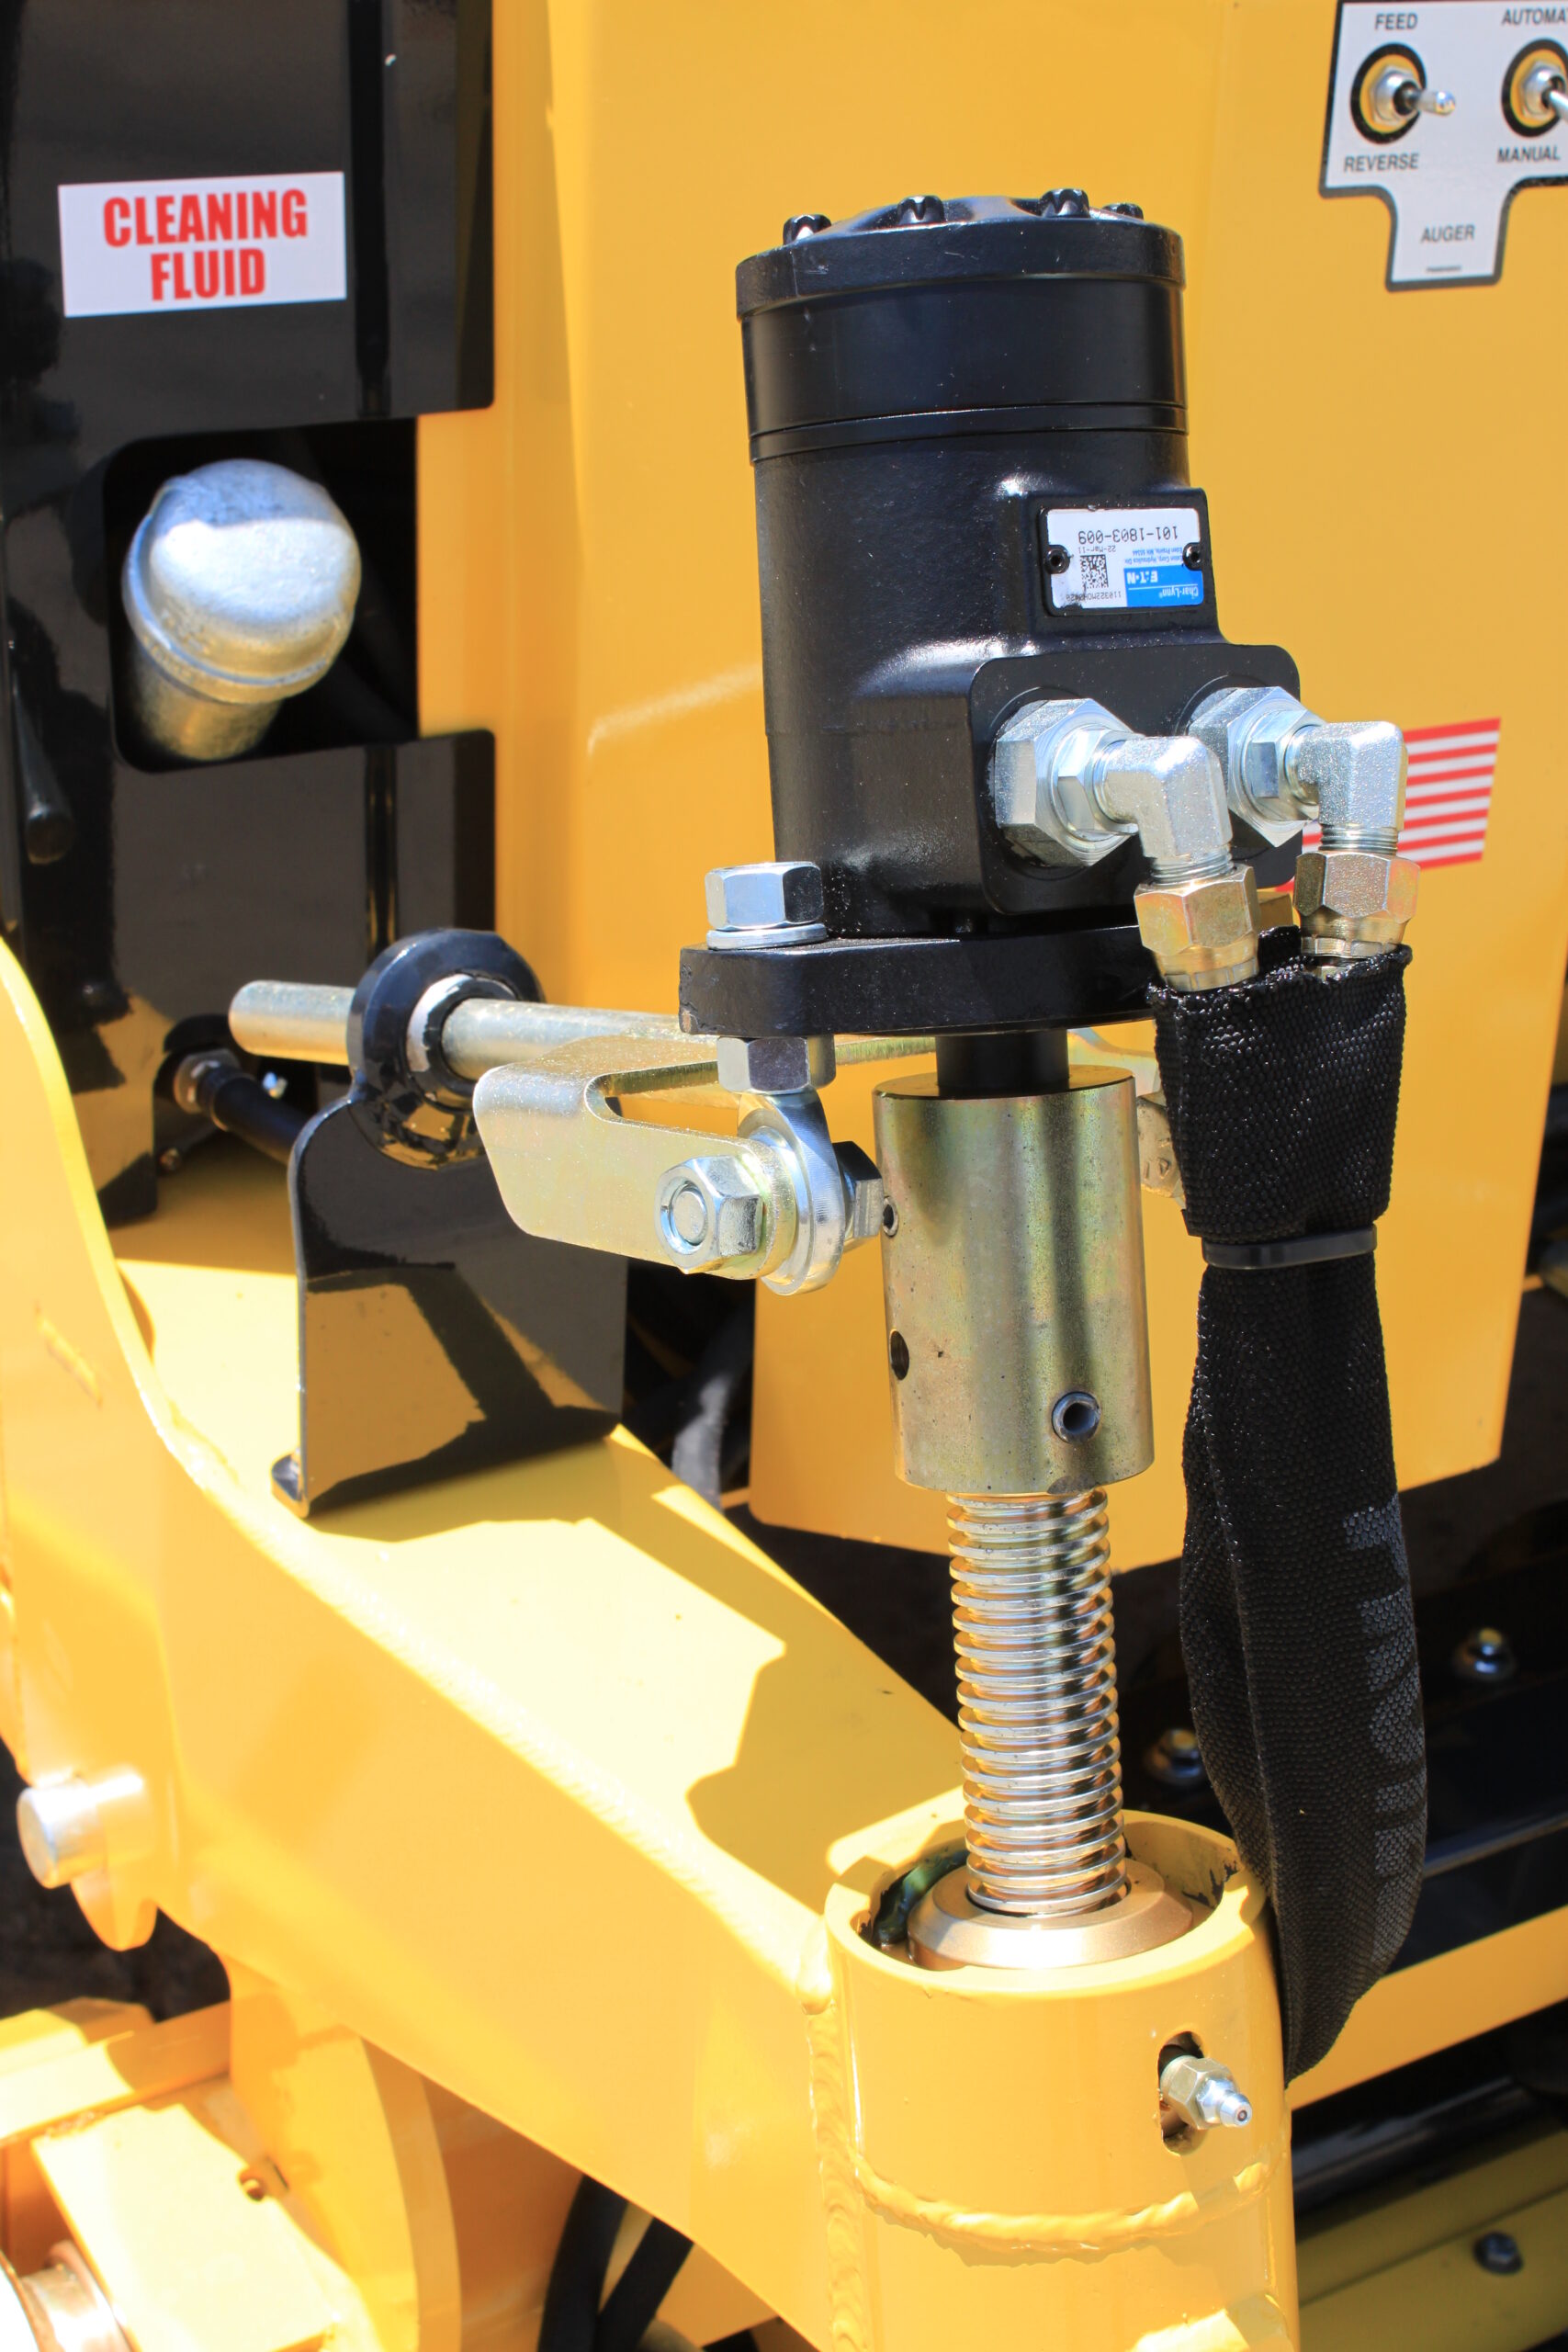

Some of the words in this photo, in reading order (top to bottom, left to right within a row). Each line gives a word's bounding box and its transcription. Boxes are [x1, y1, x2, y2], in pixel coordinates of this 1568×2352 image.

[1375, 13, 1418, 30] FEED
[1501, 7, 1568, 27] AUTOMA
[1344, 153, 1420, 173] REVERSE
[1497, 147, 1561, 164] MANUAL
[103, 188, 308, 248] CLEANING
[1421, 225, 1475, 243] AUGER
[151, 247, 265, 301] FLUID
[1077, 526, 1178, 545] 101-1803-009
[1077, 545, 1117, 554] 22-Mar-11
